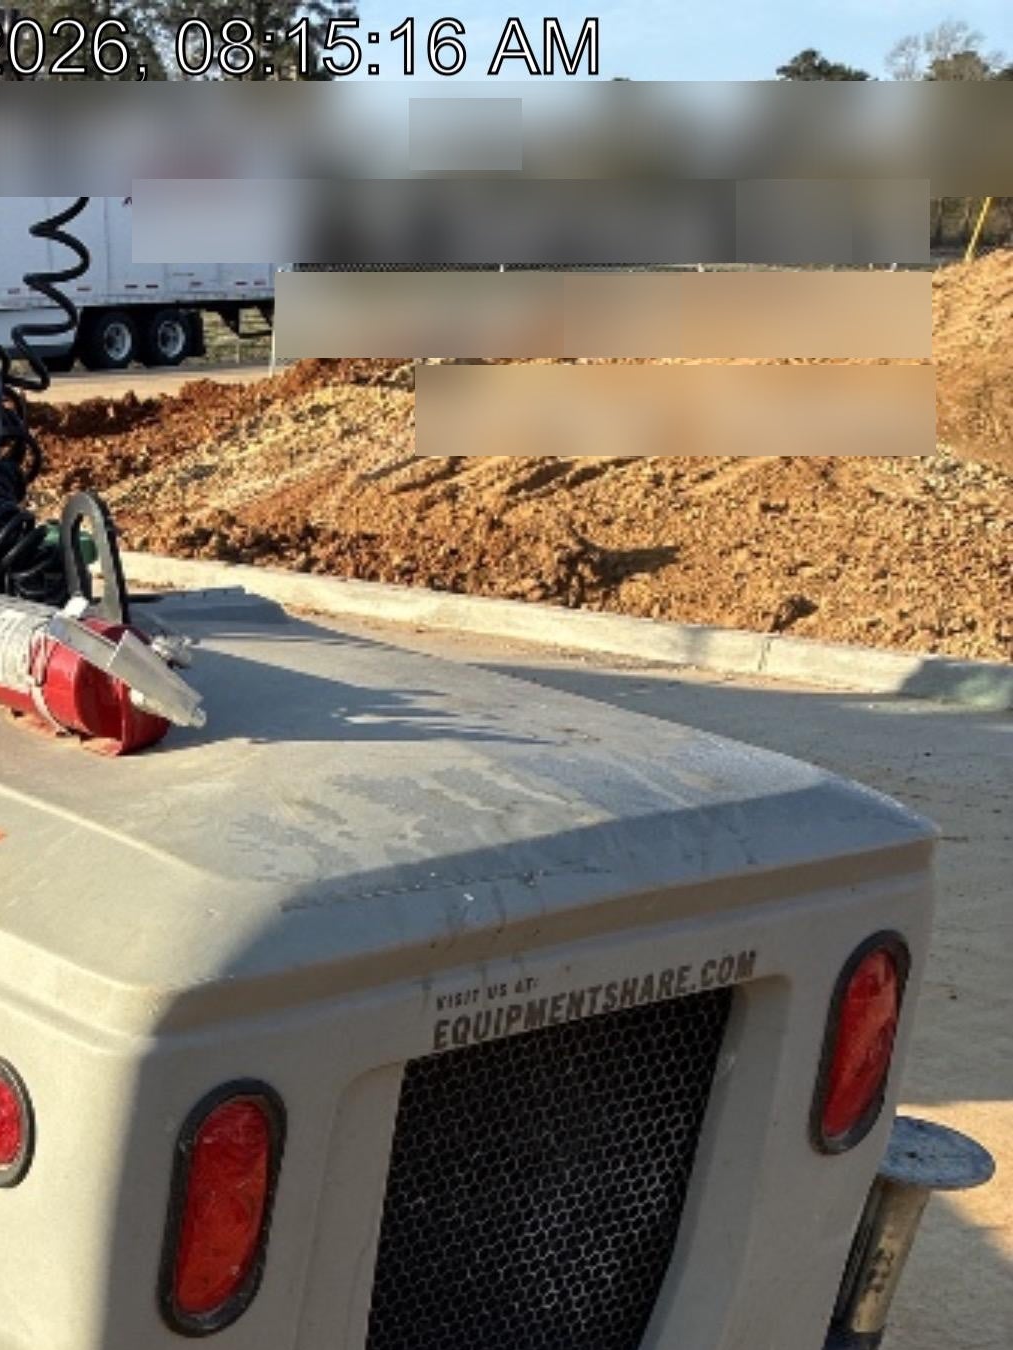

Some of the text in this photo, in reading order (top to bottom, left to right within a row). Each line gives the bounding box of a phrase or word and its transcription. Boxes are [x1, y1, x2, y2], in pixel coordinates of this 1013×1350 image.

[433, 949, 757, 1050] EQUIPMENTSHARE.COM
[436, 988, 480, 1012] VISIT
[487, 982, 508, 1000] US
